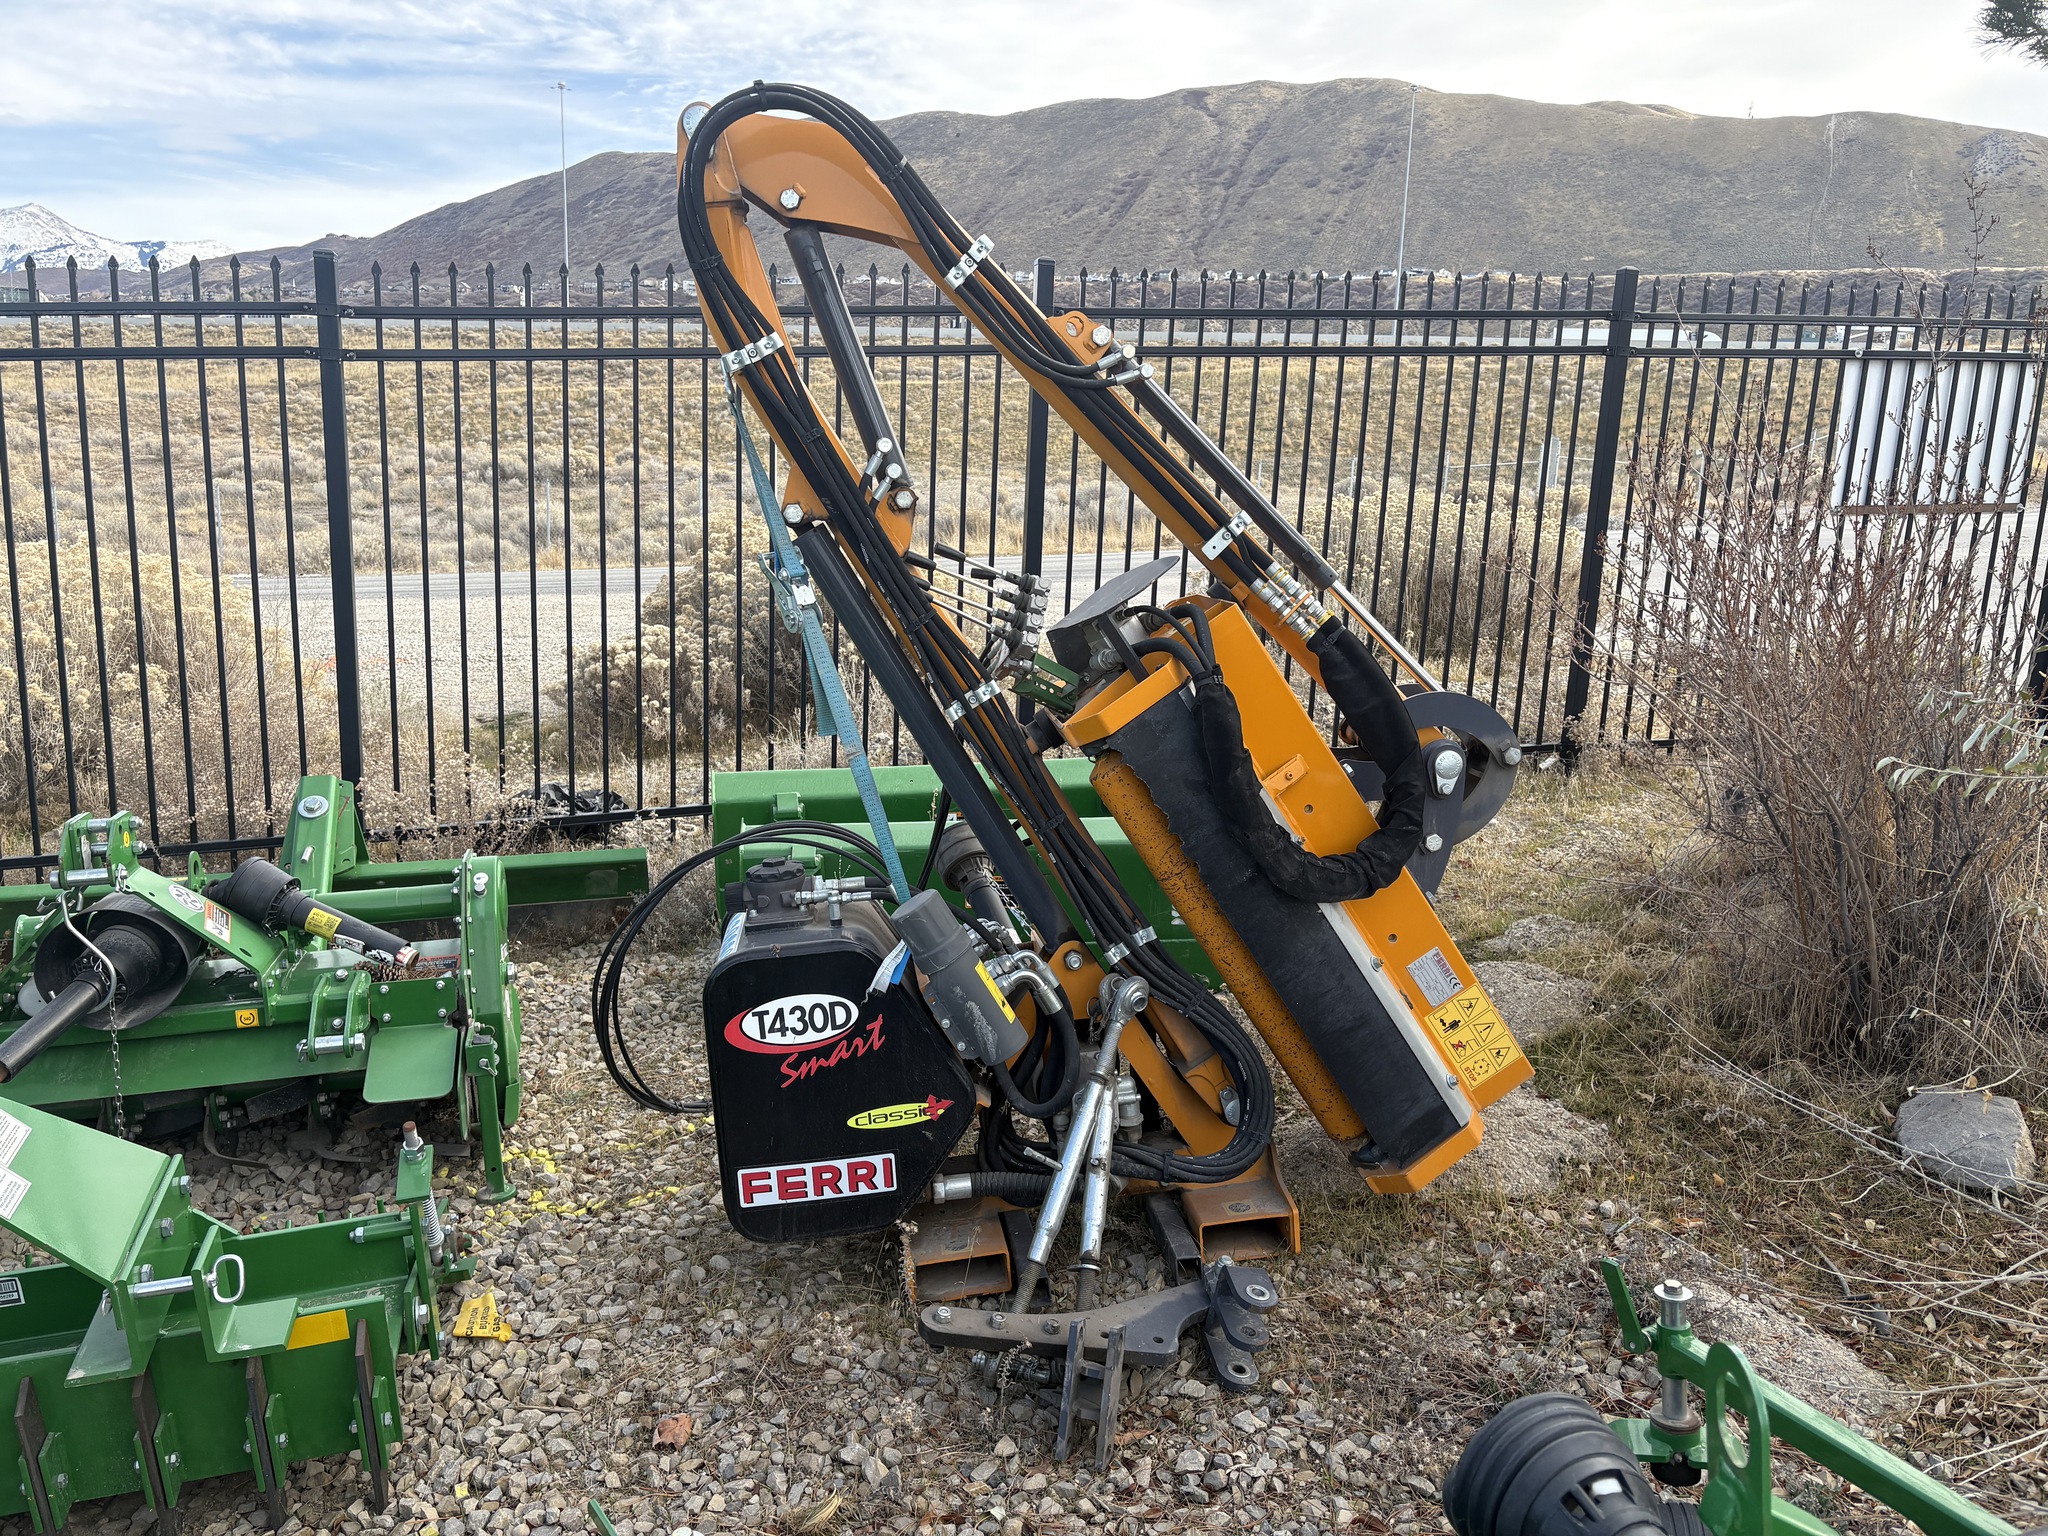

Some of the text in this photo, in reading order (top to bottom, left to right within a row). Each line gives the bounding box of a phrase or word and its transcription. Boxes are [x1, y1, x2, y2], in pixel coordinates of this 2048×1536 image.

[752, 1001, 852, 1040] T430D
[780, 1013, 886, 1088] Smart
[1463, 1066, 1478, 1083] STOP
[854, 1104, 936, 1128] classic
[741, 1157, 895, 1205] FERRI
[493, 1316, 502, 1333] GAS
